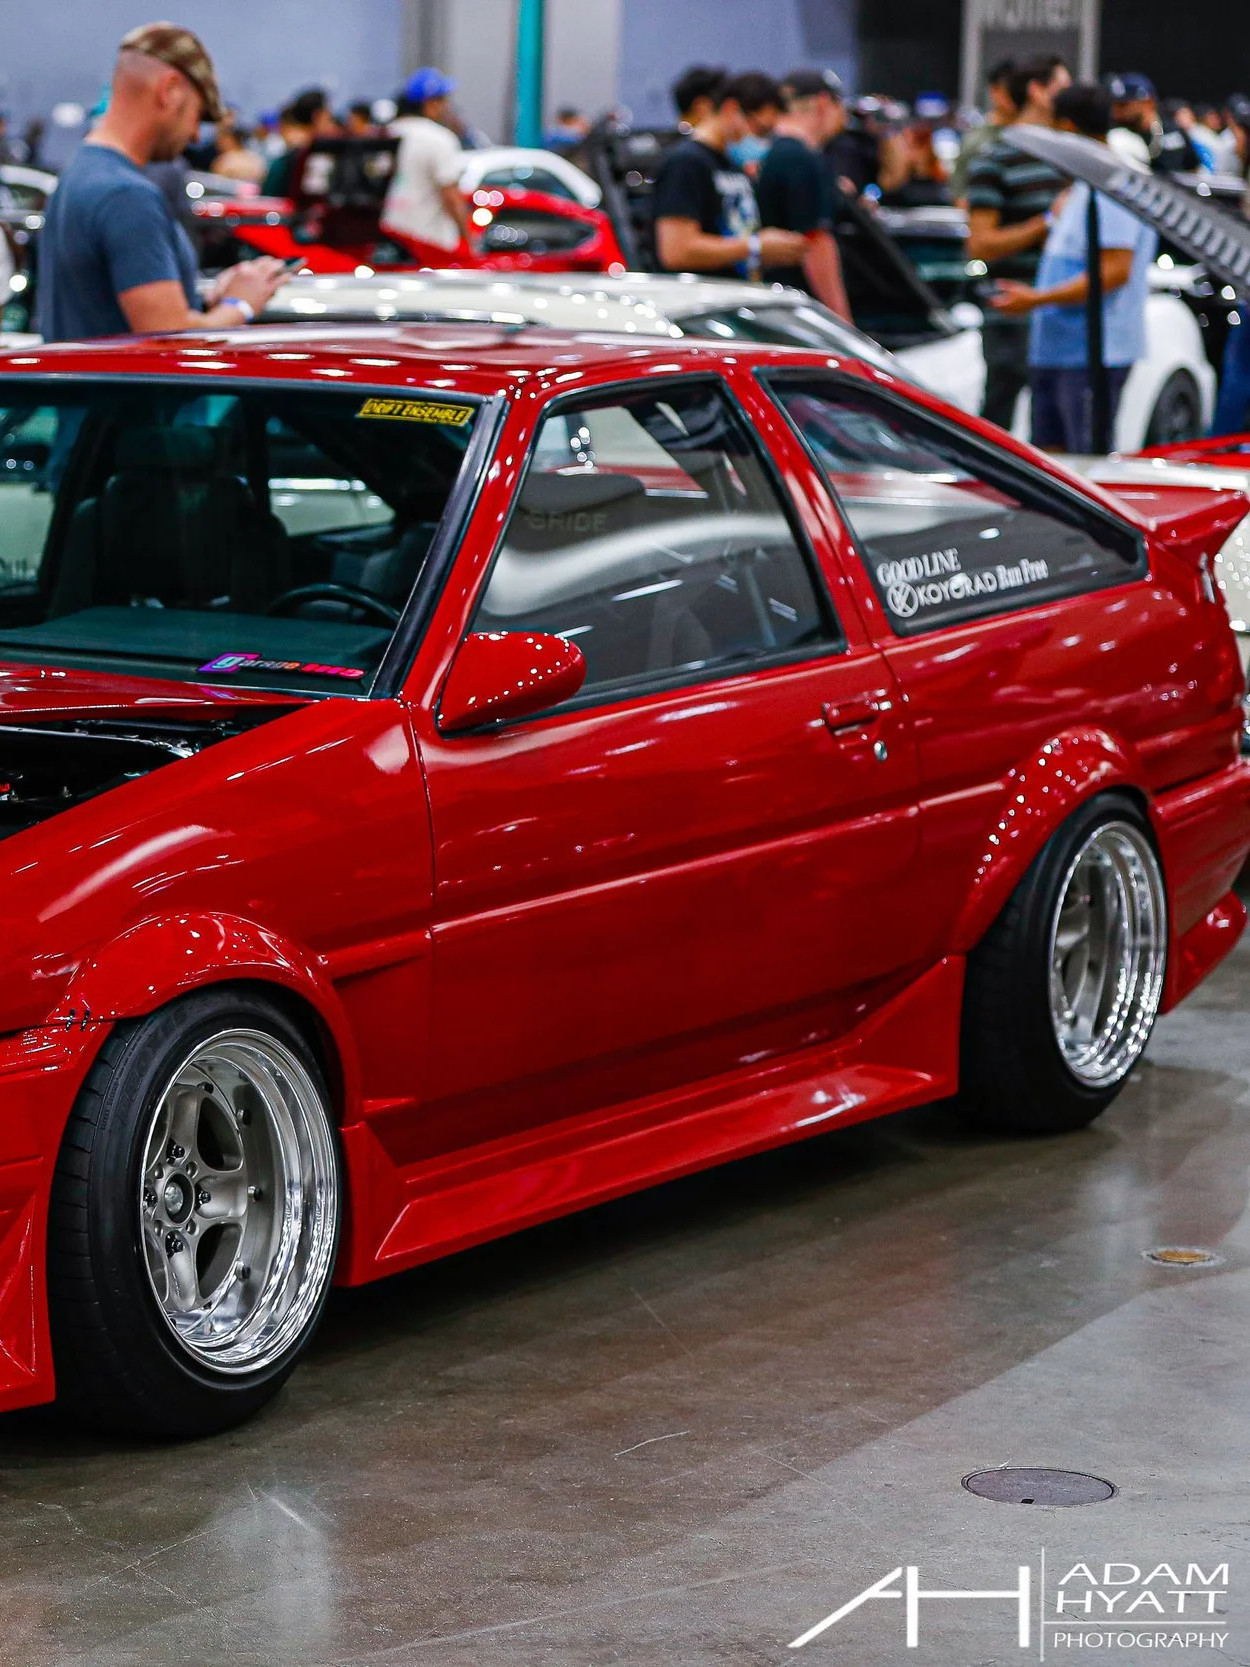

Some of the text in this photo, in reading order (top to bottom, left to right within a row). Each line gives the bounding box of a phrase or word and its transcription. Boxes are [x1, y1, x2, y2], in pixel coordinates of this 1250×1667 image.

[363, 402, 467, 421] DRIFT ENSEMBLE
[915, 572, 998, 606] KOYORAD
